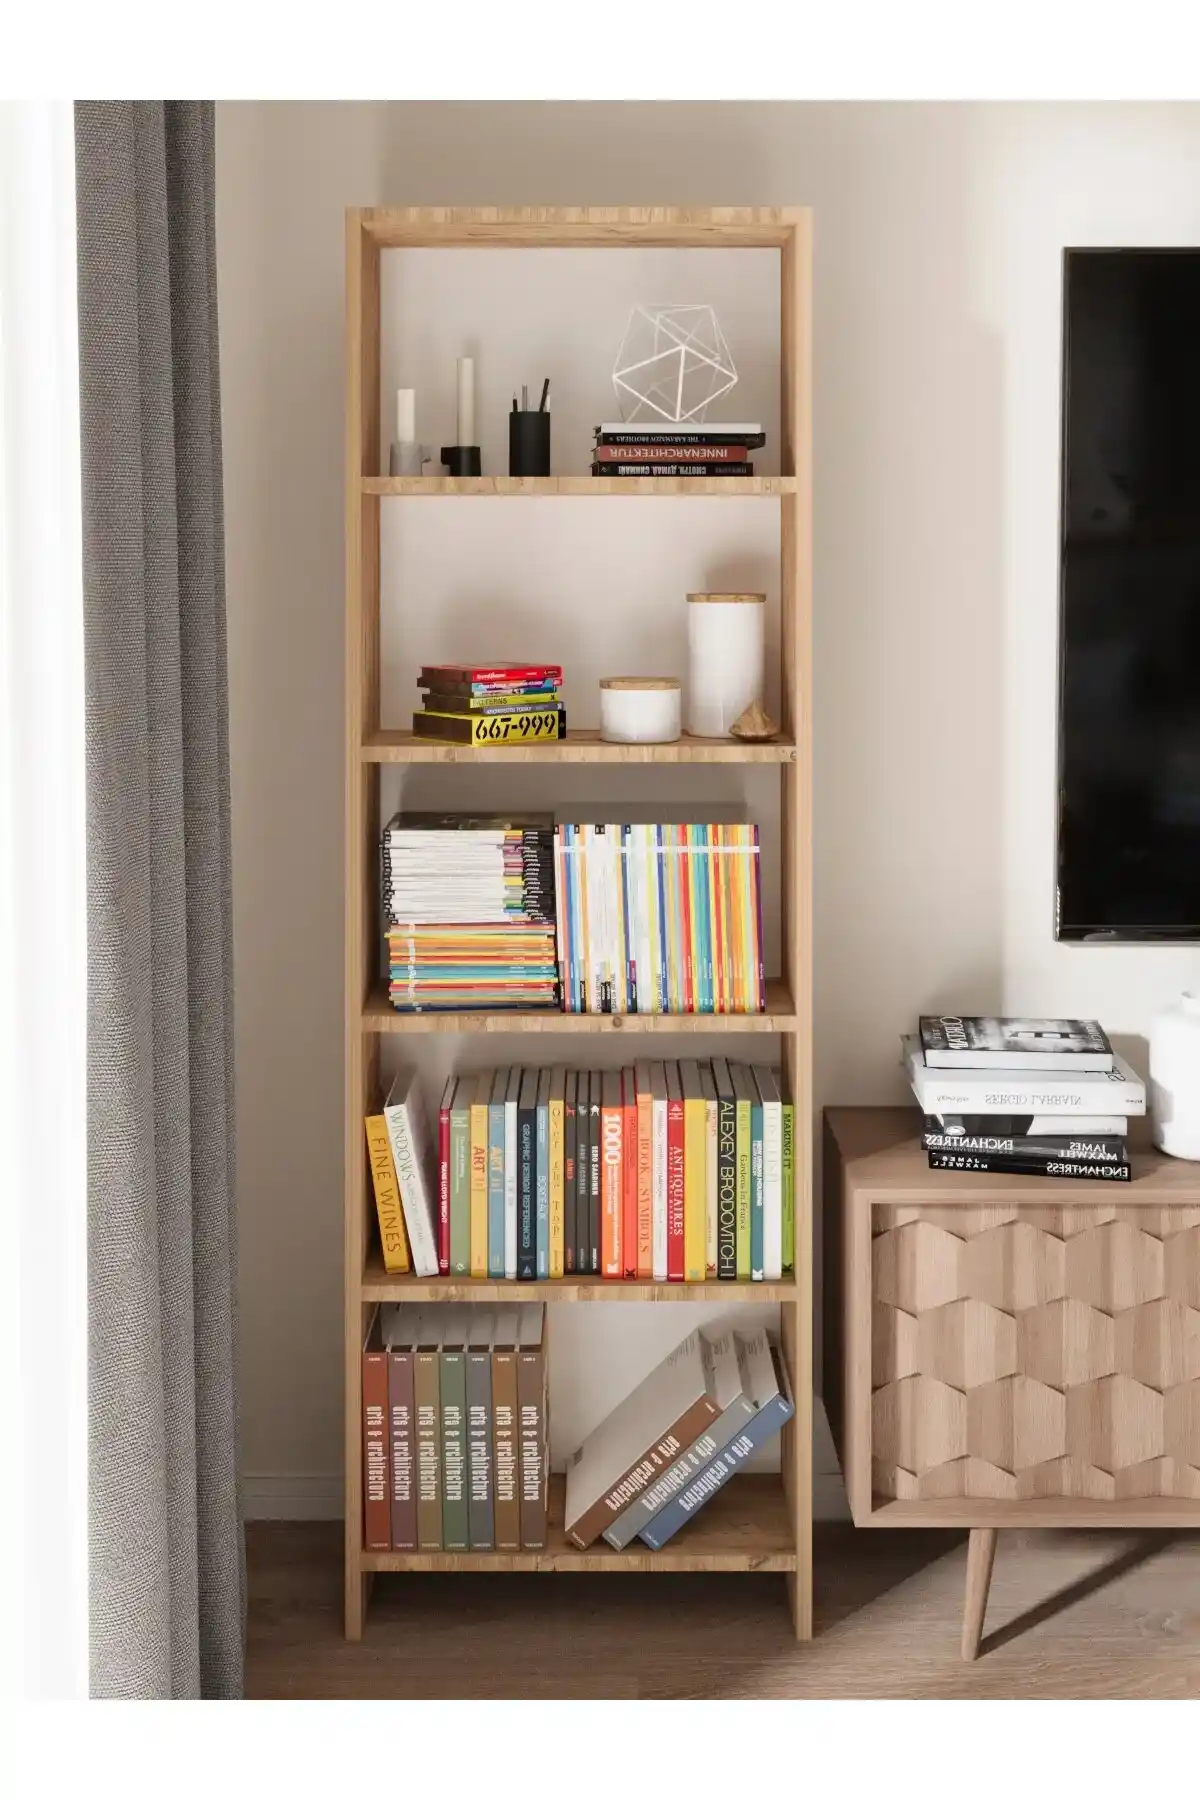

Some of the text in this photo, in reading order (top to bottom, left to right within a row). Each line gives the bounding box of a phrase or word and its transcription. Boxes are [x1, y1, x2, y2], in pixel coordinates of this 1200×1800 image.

[609, 448, 728, 458] INNENARCHITEKTUR
[472, 698, 508, 707] PATTERNS
[475, 714, 556, 740] 667-999
[389, 1111, 416, 1181] WINDOWS
[473, 1145, 485, 1173] ART
[491, 1145, 503, 1173] ART
[604, 1113, 622, 1165] 1000
[640, 1138, 649, 1174] BOOK
[783, 1113, 791, 1154] MAKING
[522, 1124, 531, 1249] GRAPHIC DESIGN REFERENCED
[720, 1100, 734, 1268] ALEXEY BRODOVITCH
[739, 1154, 748, 1189] Gardens
[783, 1157, 791, 1169] IT
[371, 1137, 401, 1253] FINE WINES
[673, 1146, 683, 1236] ANTIQUAIRES
[739, 1201, 748, 1231] France
[639, 1188, 649, 1253] SYMBOLS
[366, 1406, 388, 1501] arts & architecture
[393, 1406, 413, 1501] arts & architecture
[418, 1406, 439, 1501] arts & architecture
[444, 1406, 465, 1501] arts & architecture
[470, 1406, 490, 1501] arts & architecture
[496, 1406, 516, 1501] arts & architecture
[521, 1406, 542, 1501] arts & architecture
[657, 1435, 681, 1458] arts
[695, 1435, 717, 1458] arts
[731, 1435, 754, 1458] arts
[605, 1460, 656, 1511] architecture
[641, 1460, 692, 1511] architecture
[678, 1460, 729, 1512] architecture
